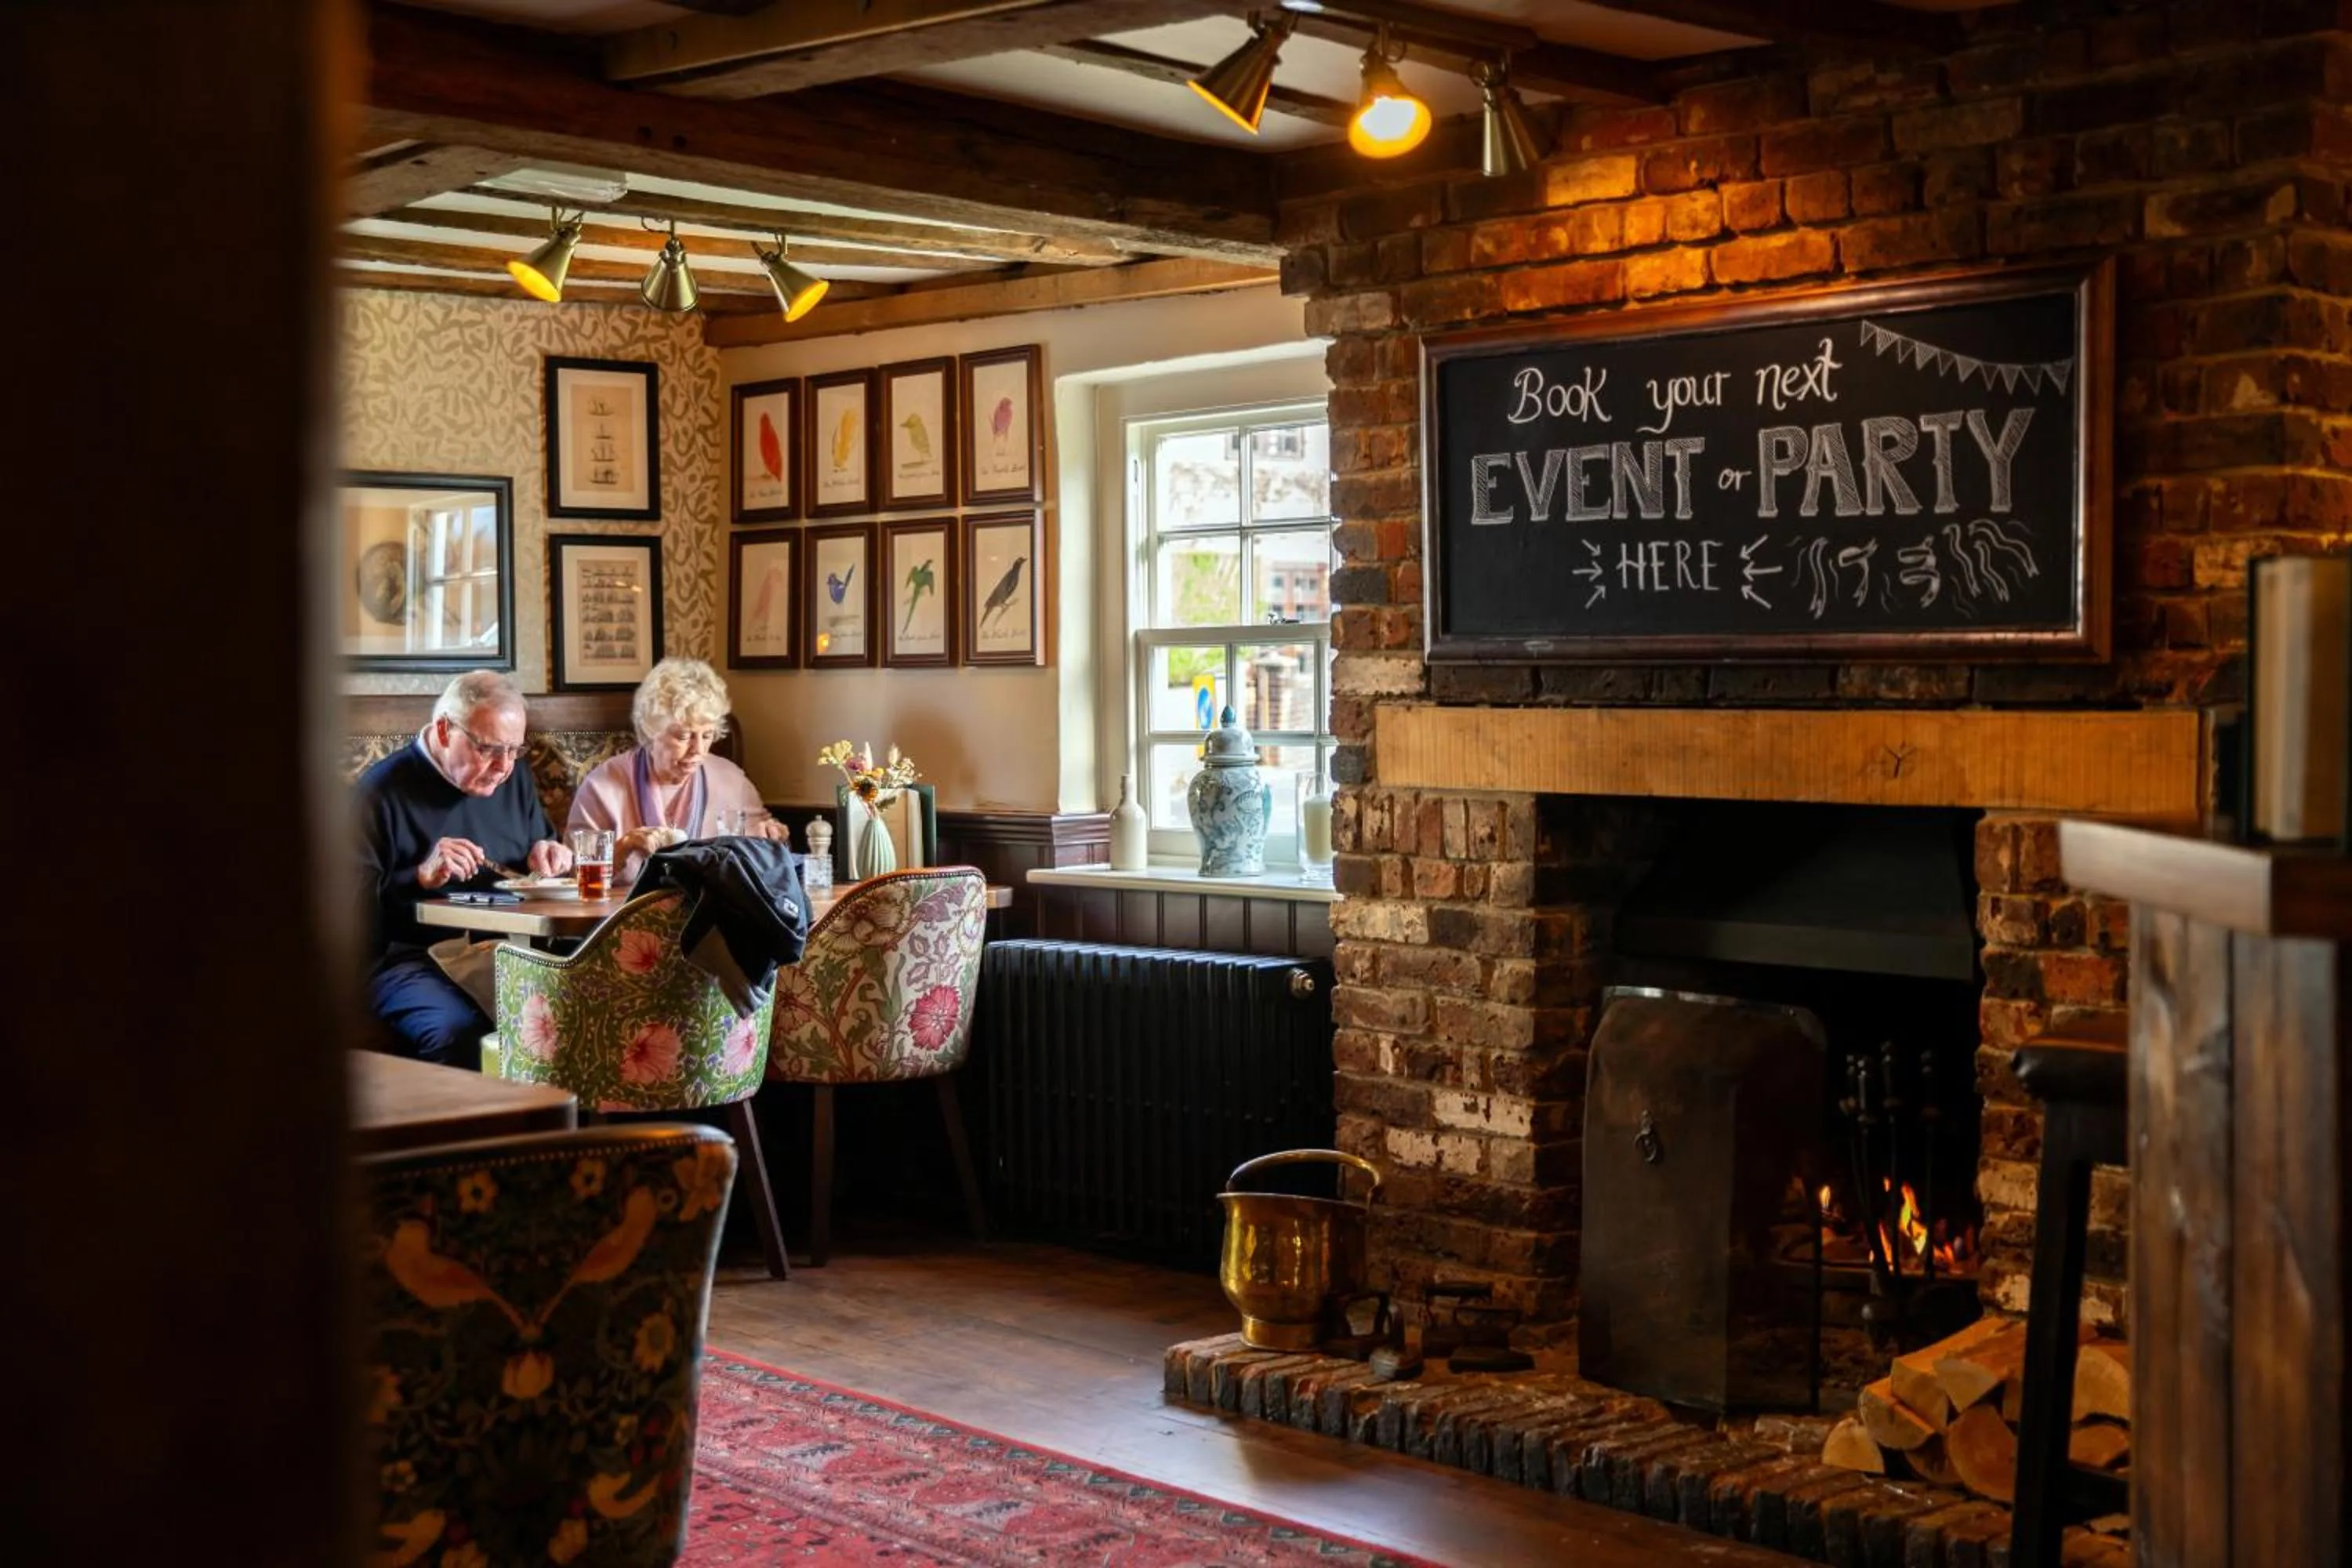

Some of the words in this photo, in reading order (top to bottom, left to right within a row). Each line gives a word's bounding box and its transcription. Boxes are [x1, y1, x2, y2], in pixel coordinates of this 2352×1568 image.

[1637, 371, 1731, 433] your
[1755, 338, 1842, 409] next
[1471, 437, 1705, 524] EVENT
[1718, 466, 1752, 491] or
[1757, 408, 2035, 517] PARTY
[1617, 539, 1722, 591] HERE
